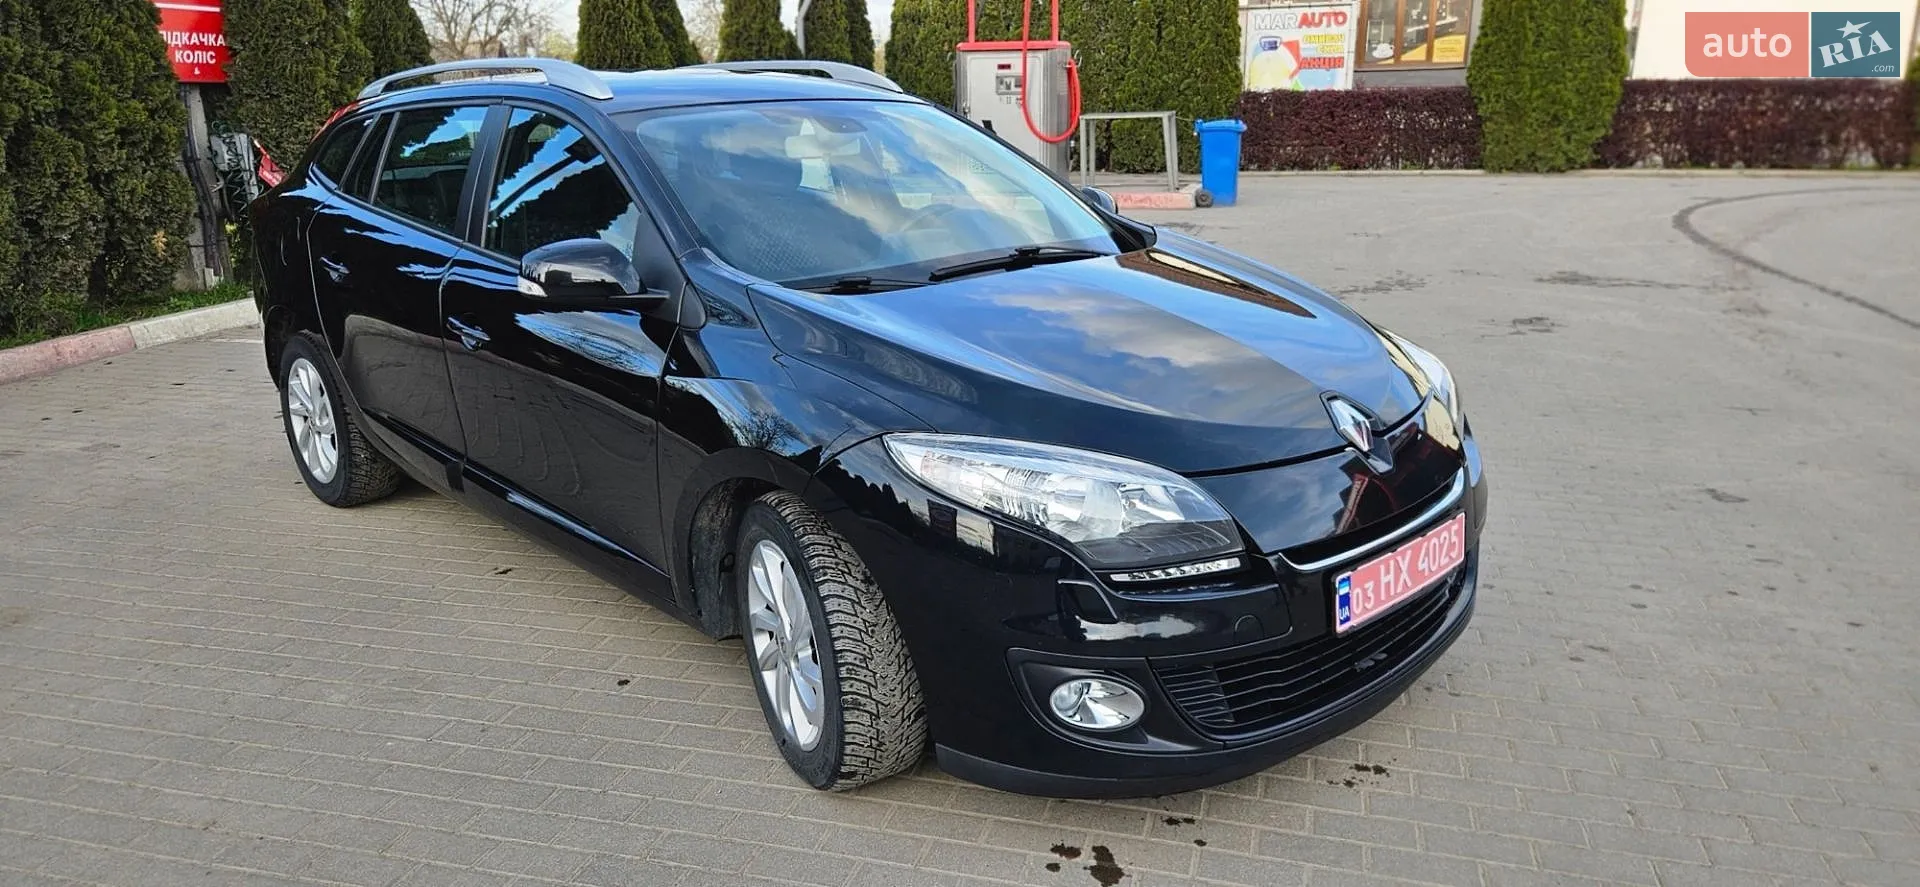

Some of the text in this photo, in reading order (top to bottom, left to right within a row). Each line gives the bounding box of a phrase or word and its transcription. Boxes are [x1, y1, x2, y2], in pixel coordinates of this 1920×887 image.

[175, 49, 216, 64] КОЛІС
[1299, 56, 1345, 71] АКЦІЯ
[1352, 525, 1459, 614] 03 HX 4025
[1339, 606, 1350, 620] UA
